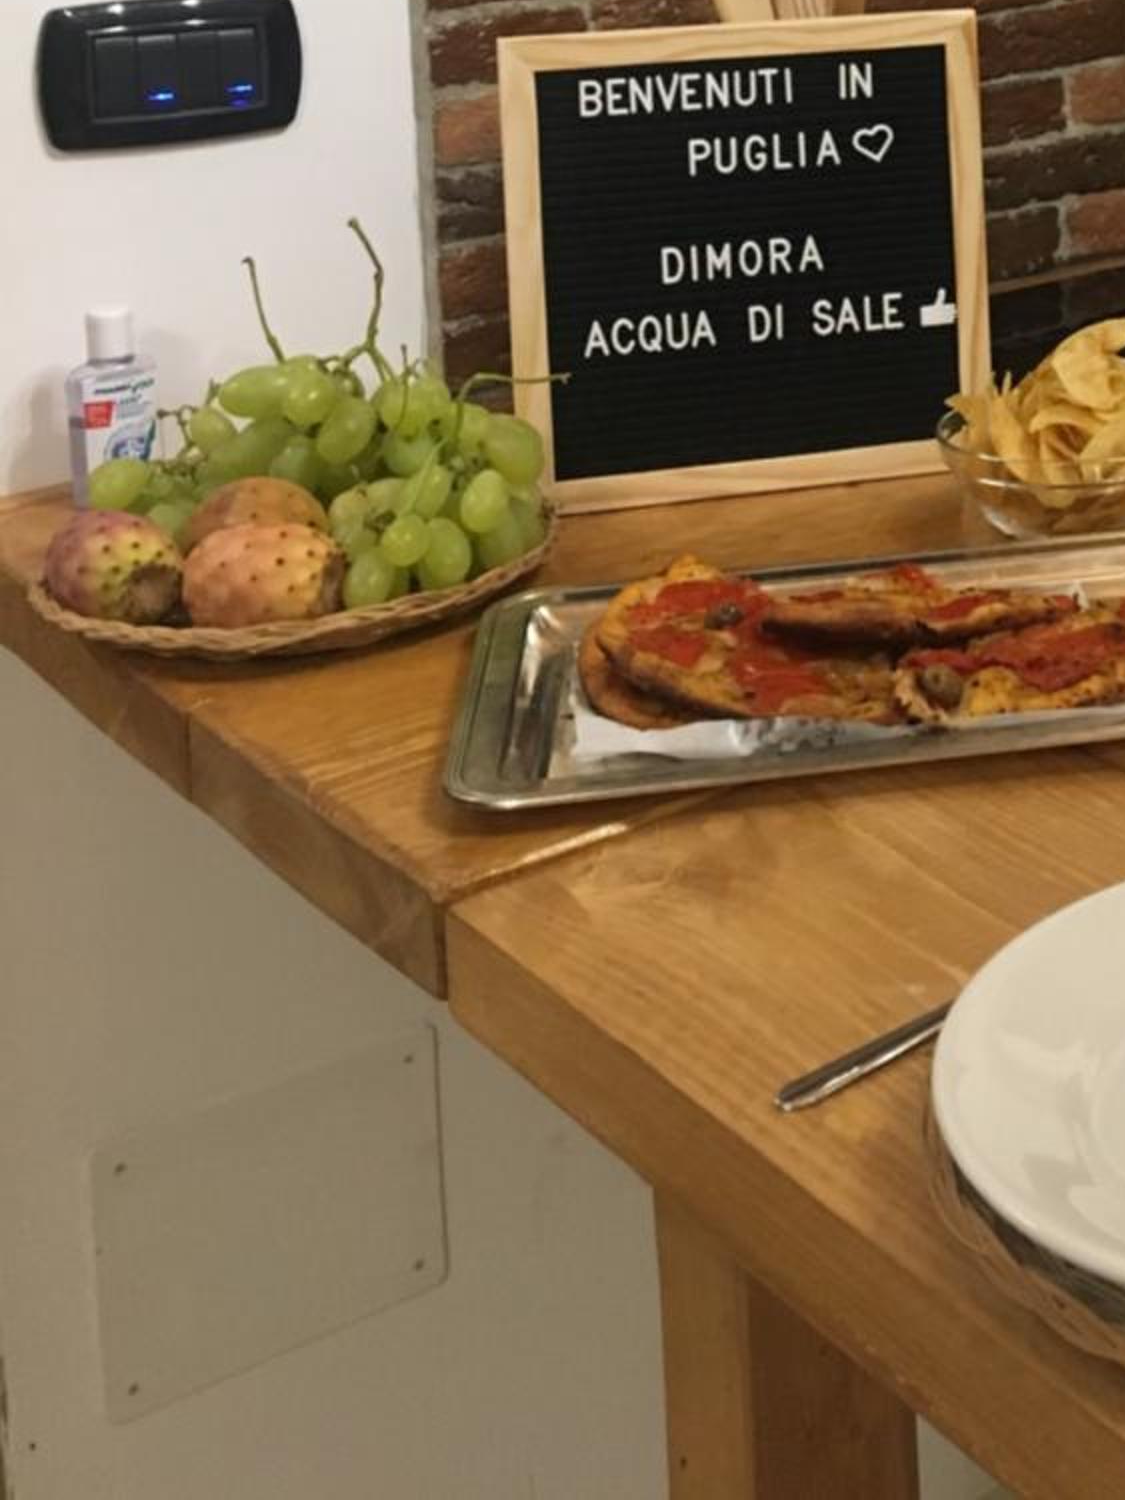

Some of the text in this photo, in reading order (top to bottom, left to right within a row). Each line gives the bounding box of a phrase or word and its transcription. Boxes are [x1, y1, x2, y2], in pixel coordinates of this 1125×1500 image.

[578, 62, 873, 118] BENVENUTI IN
[688, 129, 841, 177] PUGLIA
[660, 235, 824, 285] DIMORA
[584, 292, 905, 358] ACQUA DI SALE
